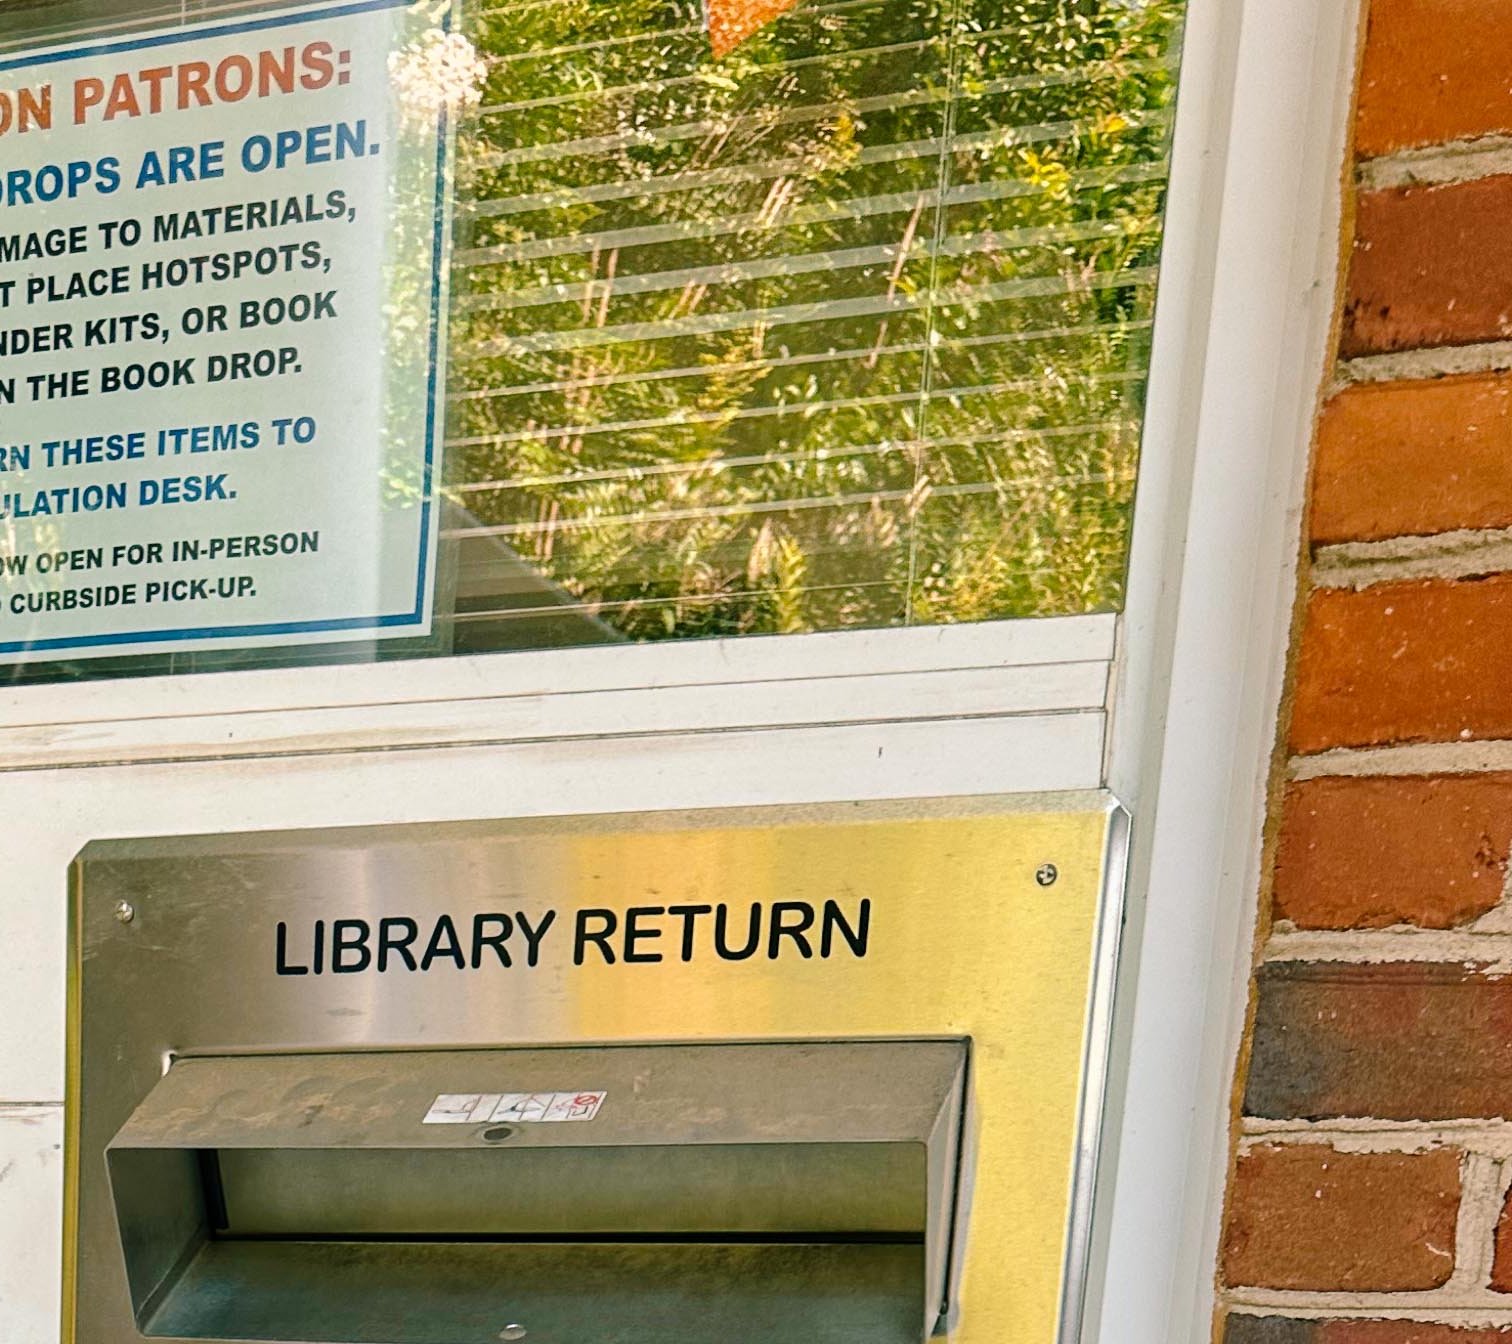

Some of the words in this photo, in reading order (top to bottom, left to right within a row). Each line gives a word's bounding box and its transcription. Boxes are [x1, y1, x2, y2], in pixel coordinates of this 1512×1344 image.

[73, 41, 351, 126] PATRONS:
[135, 140, 225, 190] ARE
[241, 119, 380, 173] OPEN.
[97, 218, 142, 250] TO
[153, 189, 356, 243] MATERIALS,
[26, 265, 131, 305] PLACE
[141, 240, 332, 291] HOTSPOTS,
[84, 312, 170, 348] KITS,
[181, 304, 229, 336] OR
[239, 289, 338, 329] BOOK
[26, 369, 90, 402] THE
[100, 357, 196, 394] BOOK
[207, 346, 302, 383] DROP.
[40, 431, 146, 468] THESE
[157, 421, 260, 457] ITEMS
[271, 416, 316, 446] TO
[138, 473, 237, 507] DESK.
[35, 547, 104, 574] OPEN
[111, 542, 164, 567] FOR
[172, 530, 320, 563] IN-PERSON
[9, 583, 137, 615] CURBSIDE
[145, 575, 257, 604] PICK-UP.
[276, 910, 555, 975] LIBRARY
[573, 898, 871, 966] RETURN
